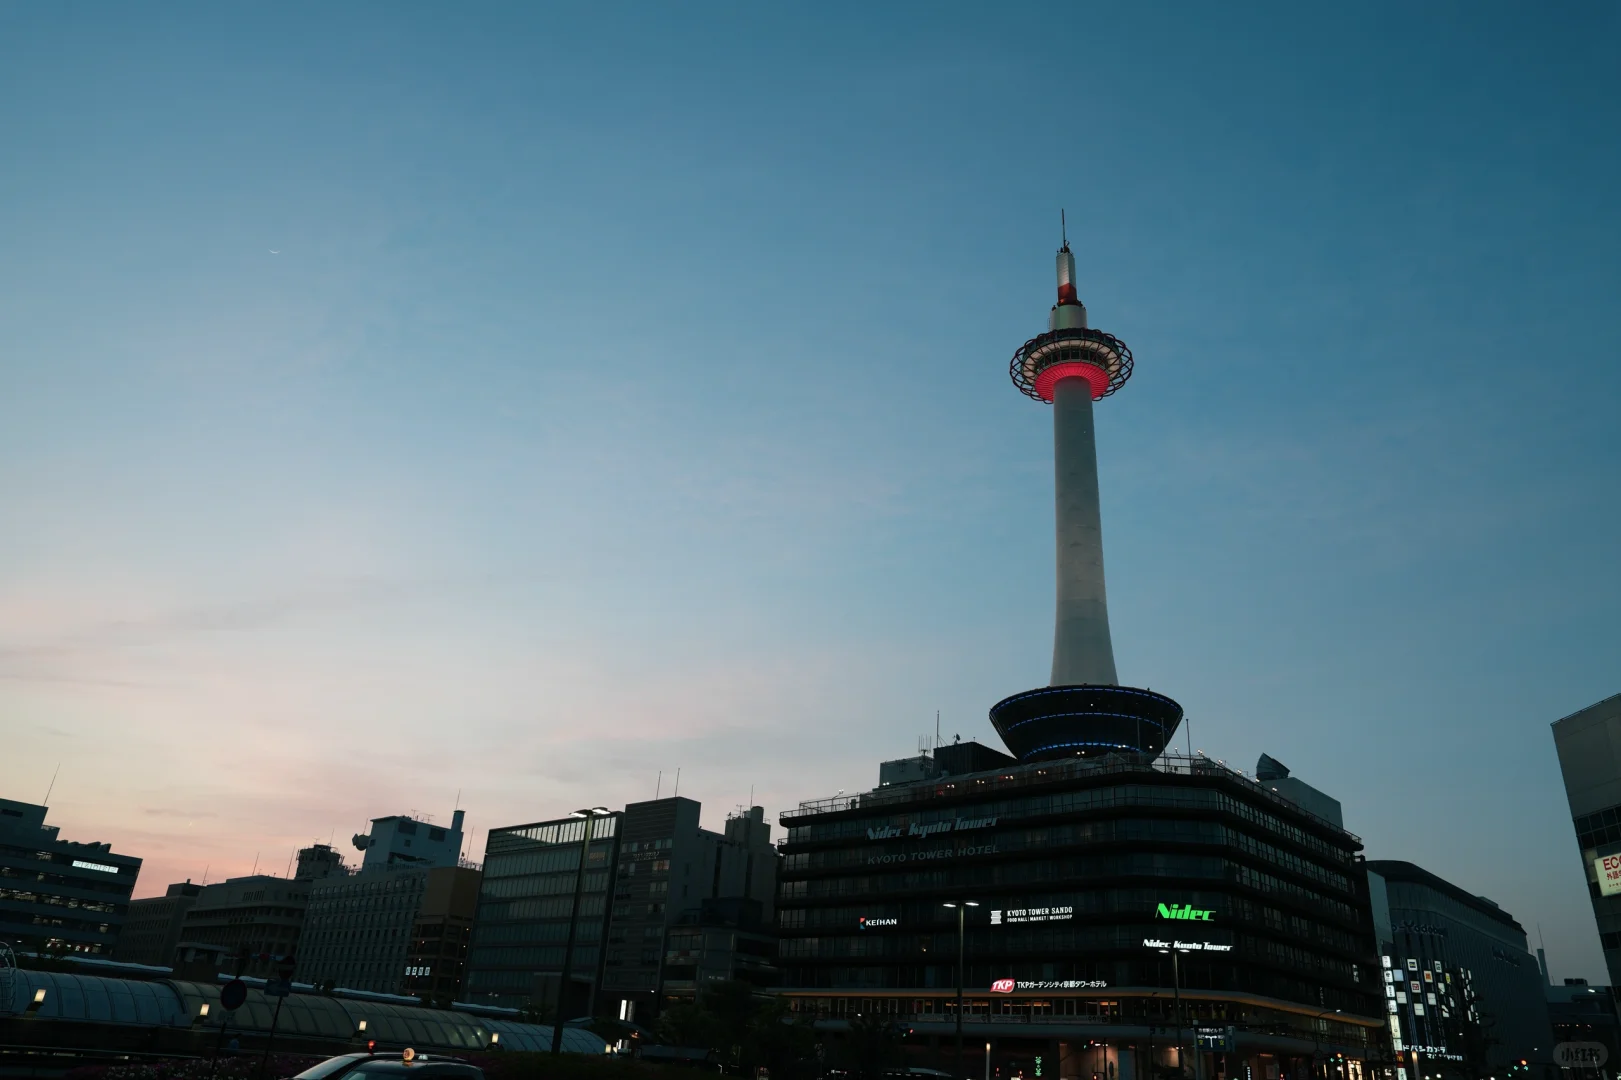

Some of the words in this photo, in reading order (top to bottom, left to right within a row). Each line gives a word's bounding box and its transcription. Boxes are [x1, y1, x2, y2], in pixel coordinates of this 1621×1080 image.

[866, 825, 904, 840] Nidec
[908, 822, 952, 839] Kyoto
[954, 817, 997, 831] Tower
[868, 853, 907, 865] KYOTO
[911, 849, 953, 861] TOWER
[957, 845, 999, 857] HOTEL
[1603, 855, 1621, 871] EC
[1007, 909, 1027, 917] KYOTO
[1051, 906, 1073, 914] SANDO
[1155, 903, 1216, 921] Nidec
[865, 918, 898, 927] KEIHAN
[1142, 938, 1171, 948] Nidec
[1173, 940, 1202, 950] Kyoto
[1203, 941, 1233, 951] Tower
